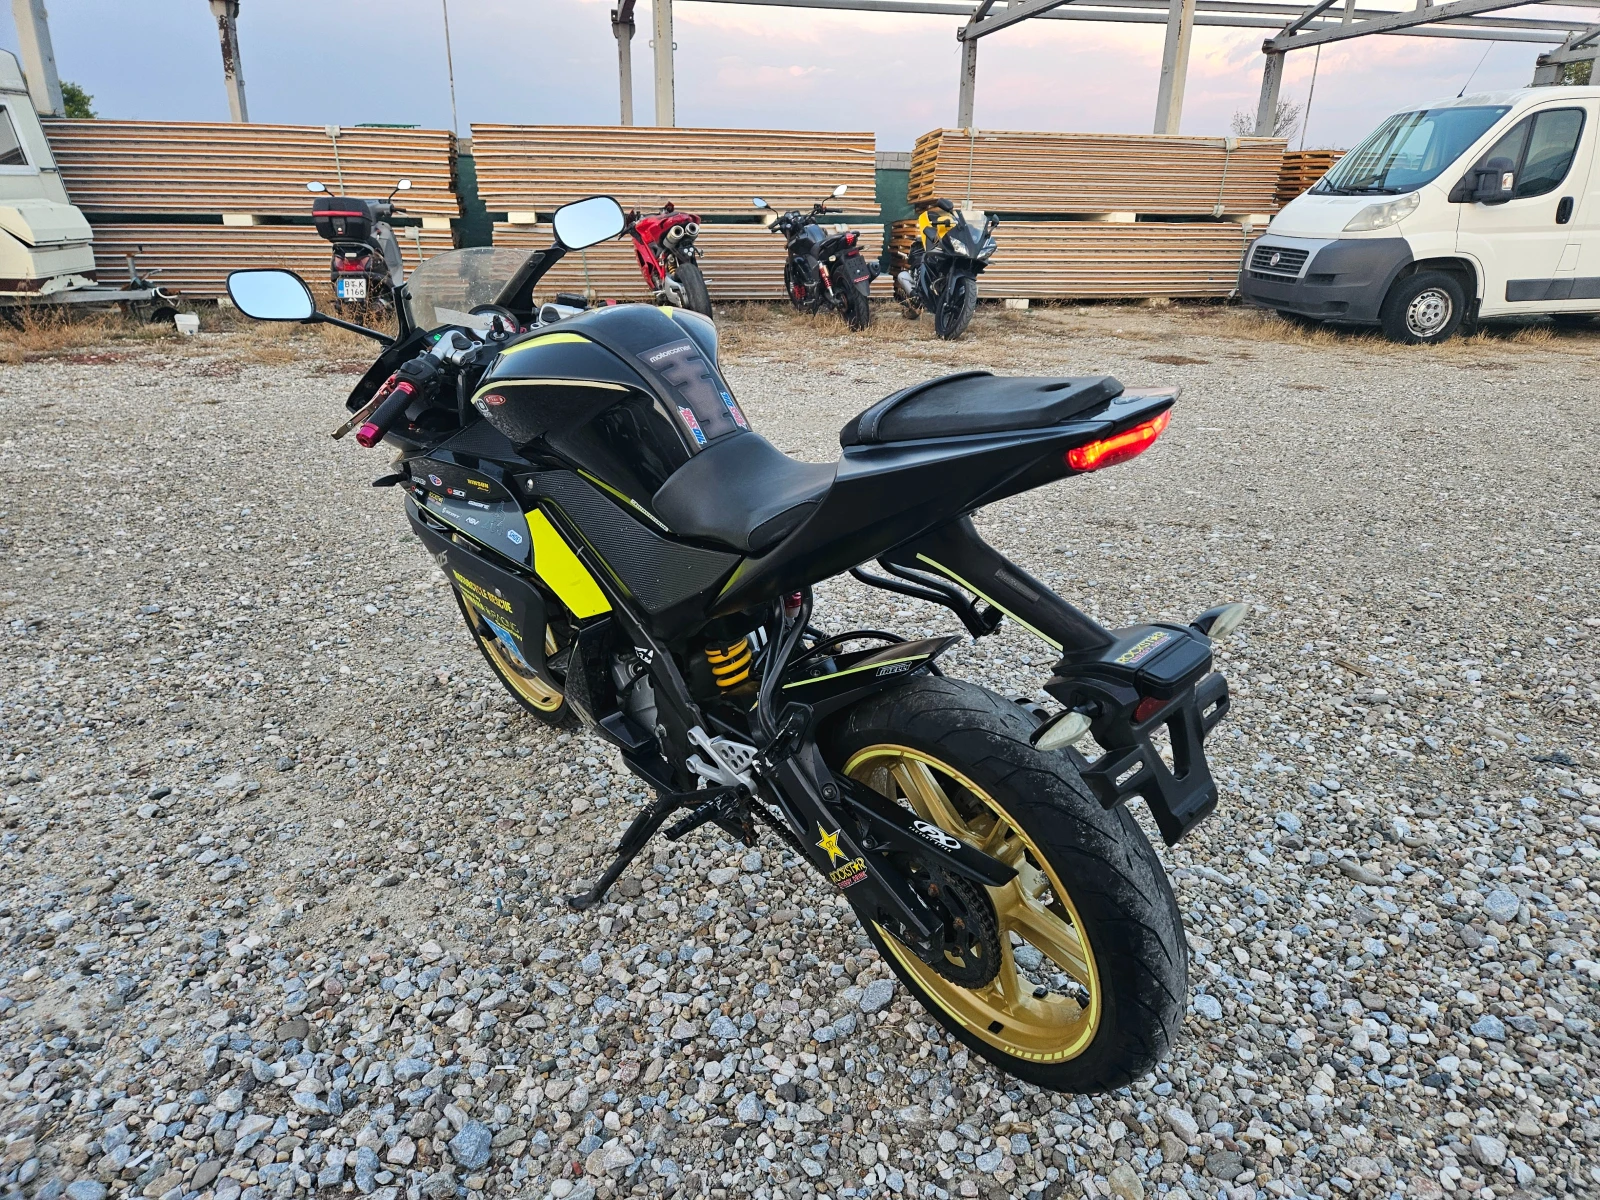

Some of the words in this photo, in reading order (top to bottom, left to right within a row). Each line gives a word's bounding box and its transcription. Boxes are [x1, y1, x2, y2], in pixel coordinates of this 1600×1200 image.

[649, 345, 692, 363] motorcorner
[678, 406, 708, 445] AMSOIL
[508, 531, 522, 543] SHOEI
[829, 857, 867, 884] ROCKSTAR
